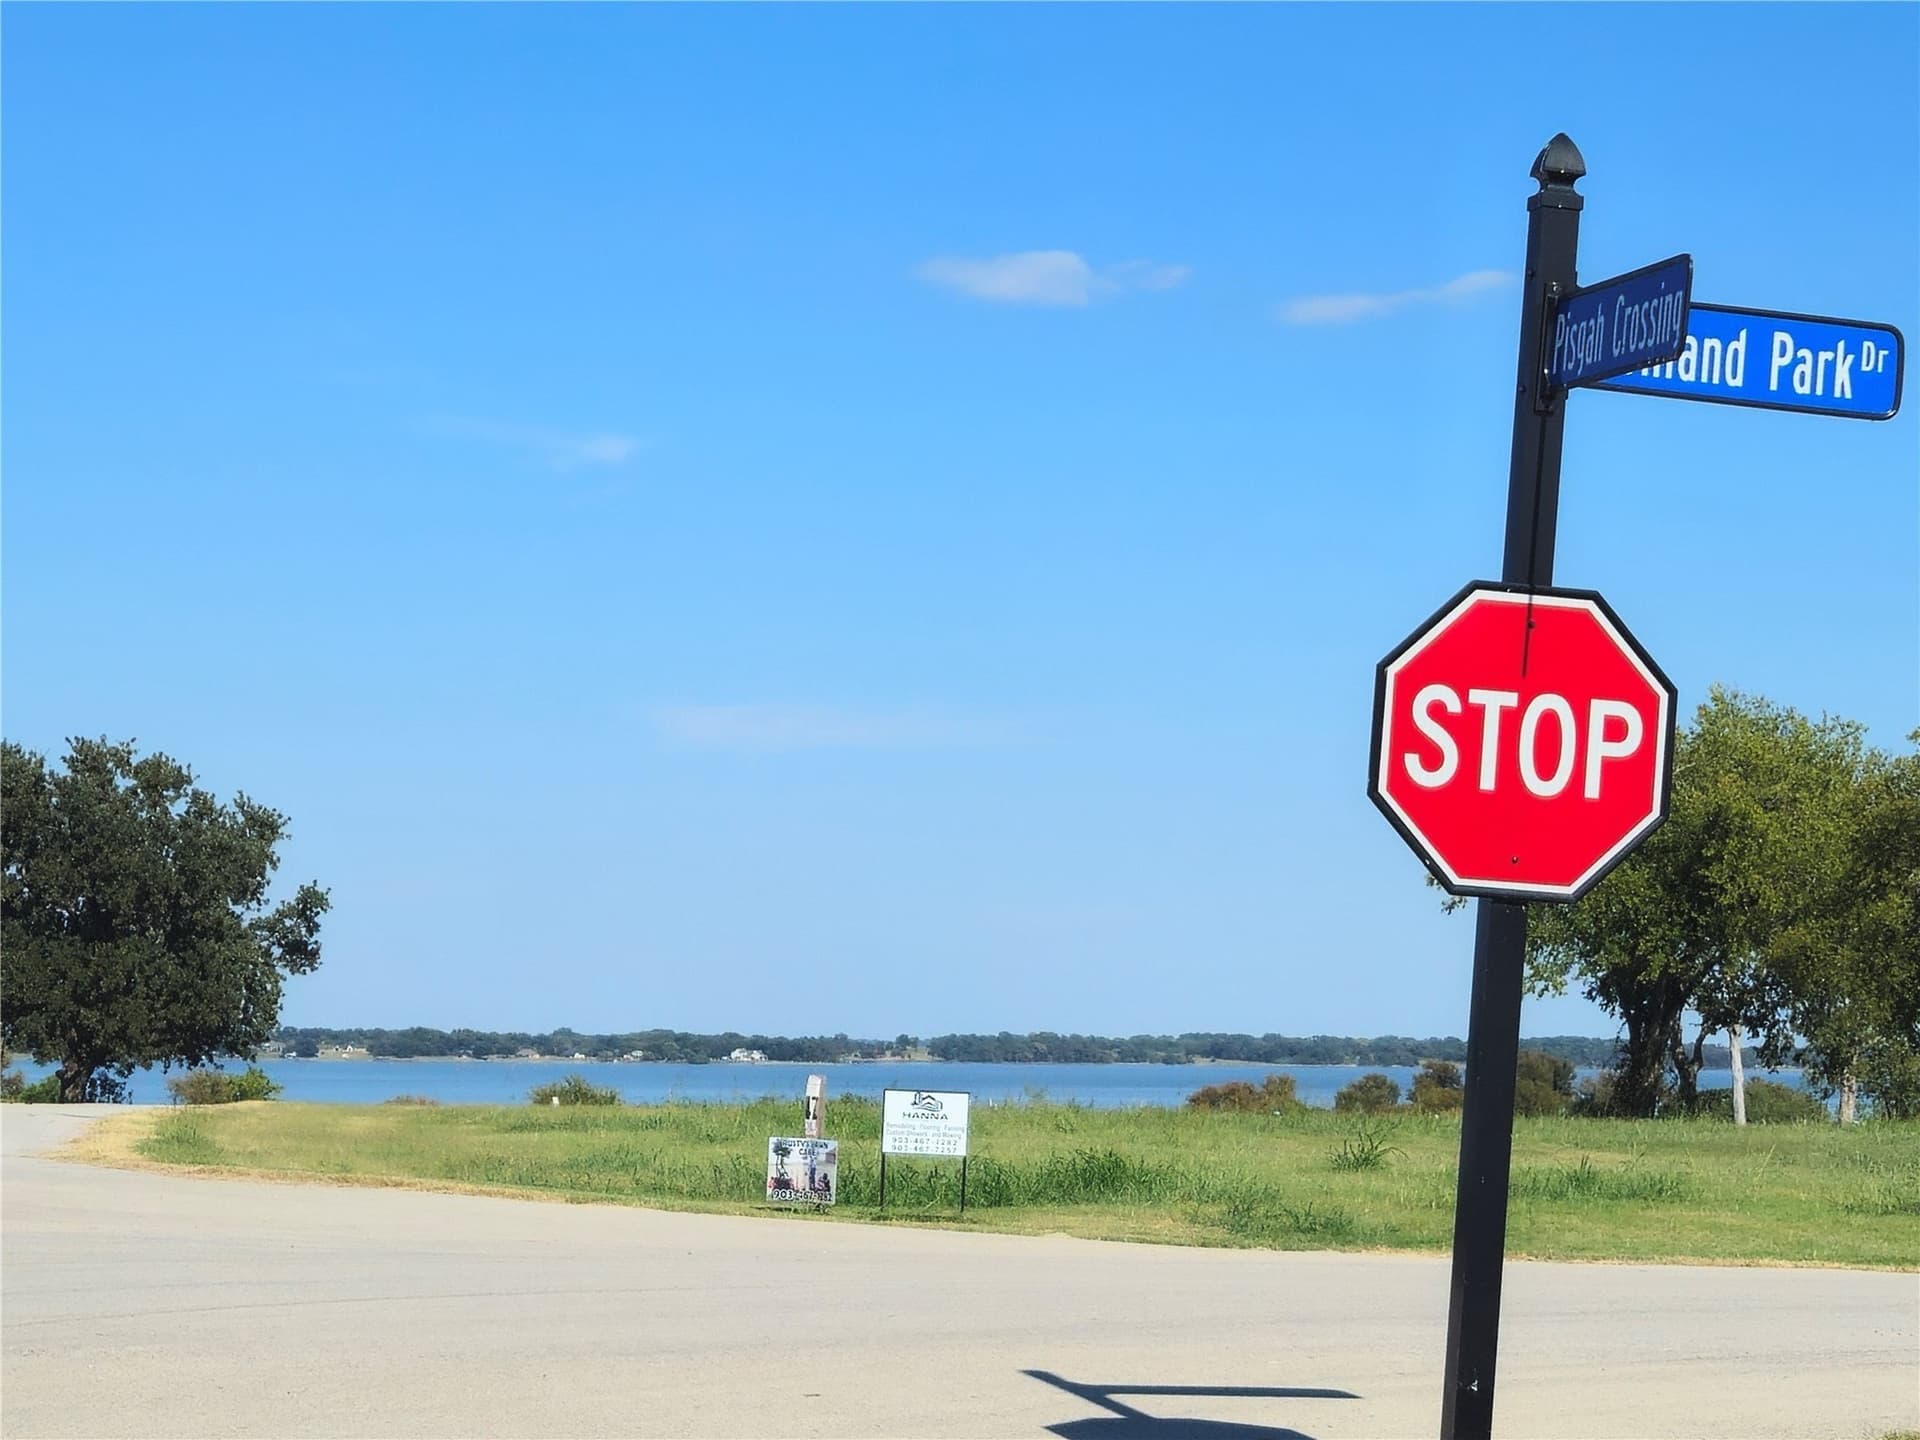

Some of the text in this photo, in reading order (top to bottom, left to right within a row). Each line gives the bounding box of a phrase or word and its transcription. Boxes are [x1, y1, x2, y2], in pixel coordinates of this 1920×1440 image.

[1553, 281, 1684, 374] Pisgah Crossing
[1625, 327, 1890, 400] and Park Dr
[1403, 683, 1644, 800] STOP
[902, 1111, 949, 1120] HANNA
